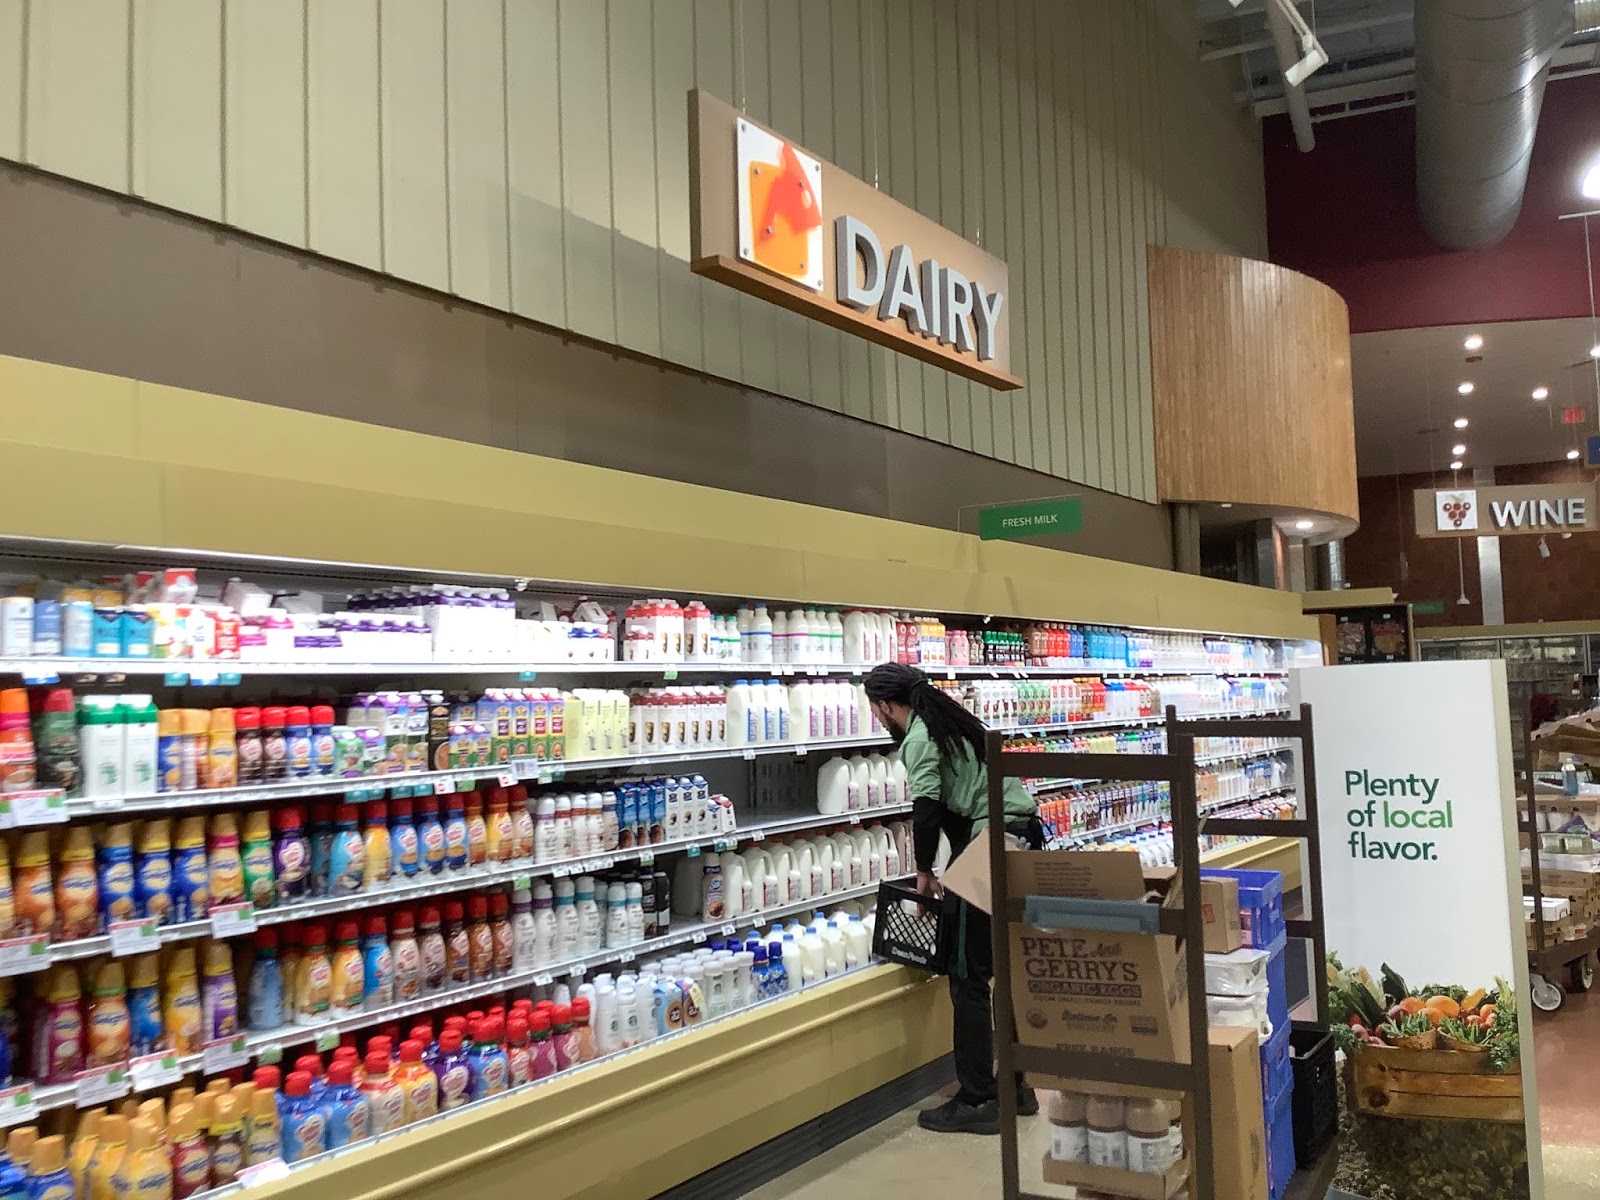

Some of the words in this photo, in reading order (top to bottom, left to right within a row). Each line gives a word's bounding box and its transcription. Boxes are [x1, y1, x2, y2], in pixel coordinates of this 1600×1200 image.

[836, 215, 1004, 361] DAIRY
[1002, 516, 1032, 528] FRESH
[1034, 513, 1058, 525] MILK
[1490, 498, 1588, 528] WINE
[1345, 769, 1440, 804] Plenty
[1347, 800, 1376, 827] of
[1383, 800, 1453, 828] local
[1348, 831, 1438, 860] flavor.
[1020, 937, 1089, 958] PETE
